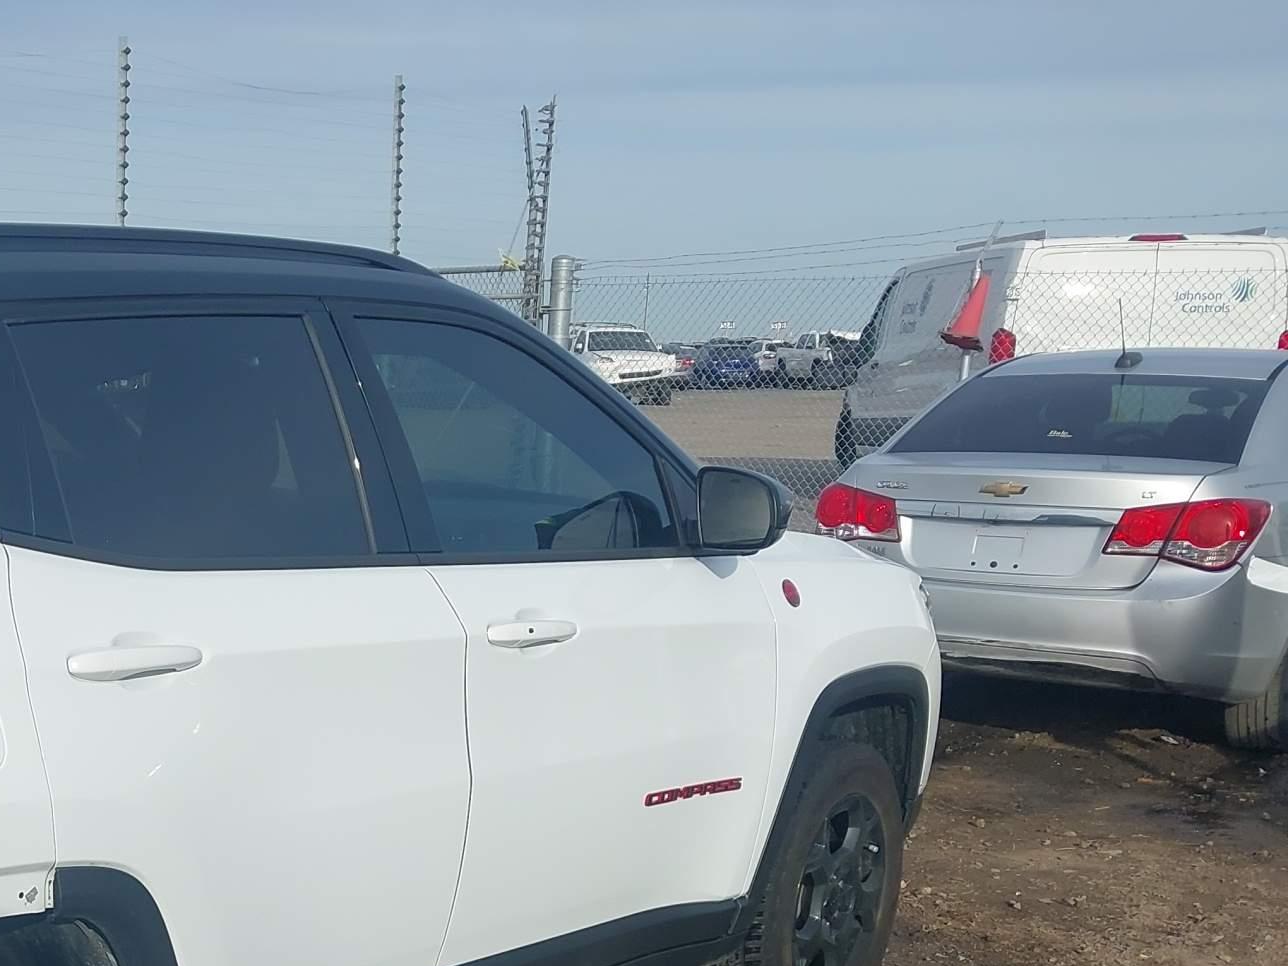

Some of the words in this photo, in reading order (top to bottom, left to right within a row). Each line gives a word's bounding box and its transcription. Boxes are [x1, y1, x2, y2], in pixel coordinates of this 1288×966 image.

[1174, 290, 1223, 302] Johnson
[1182, 302, 1231, 313] Controls
[644, 777, 743, 807] COMPASS
